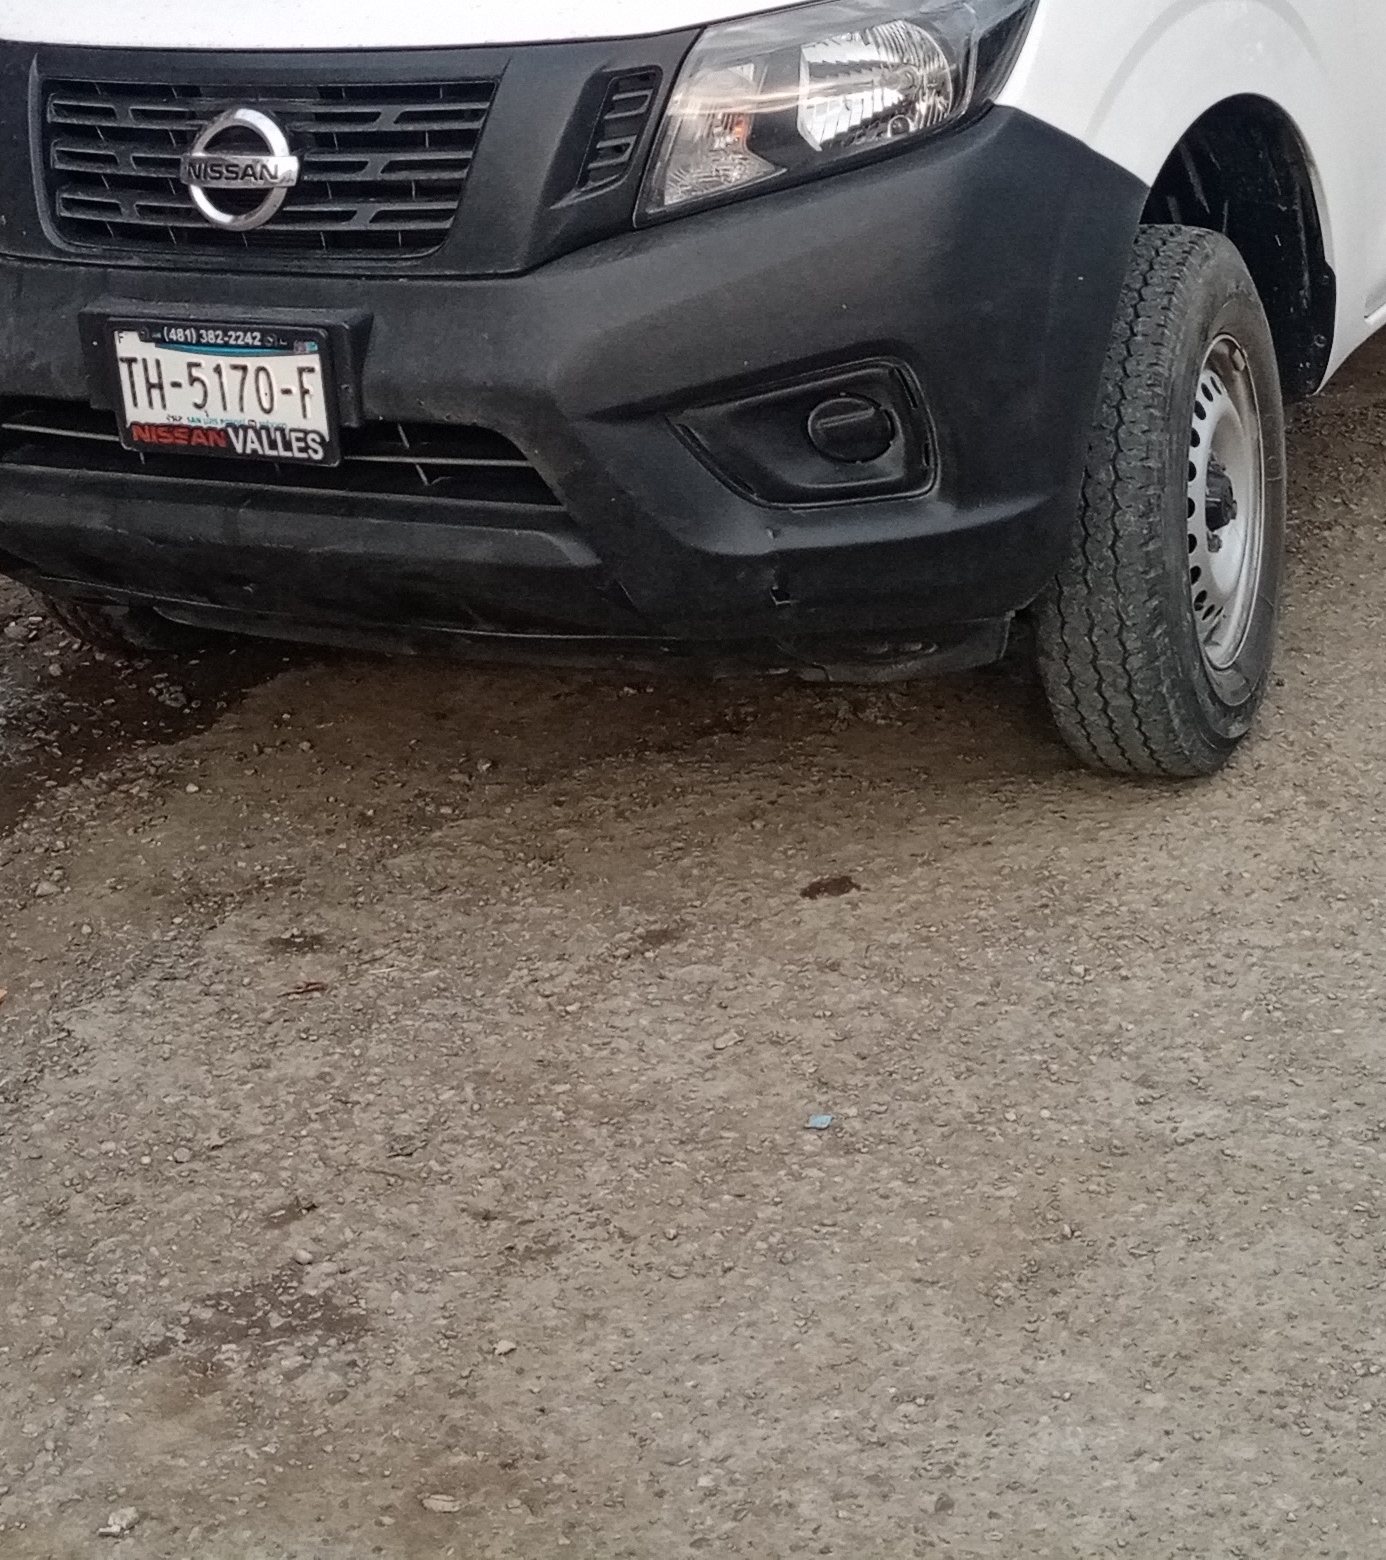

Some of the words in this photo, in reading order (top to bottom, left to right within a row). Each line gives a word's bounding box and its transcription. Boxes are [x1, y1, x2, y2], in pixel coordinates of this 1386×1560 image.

[187, 163, 279, 181] NISSAN
[163, 326, 197, 343] (481)
[200, 329, 262, 346] 382-2242
[119, 356, 316, 419] TH-5170-F
[132, 424, 228, 448] NISSAN
[227, 426, 324, 460] VALLES
